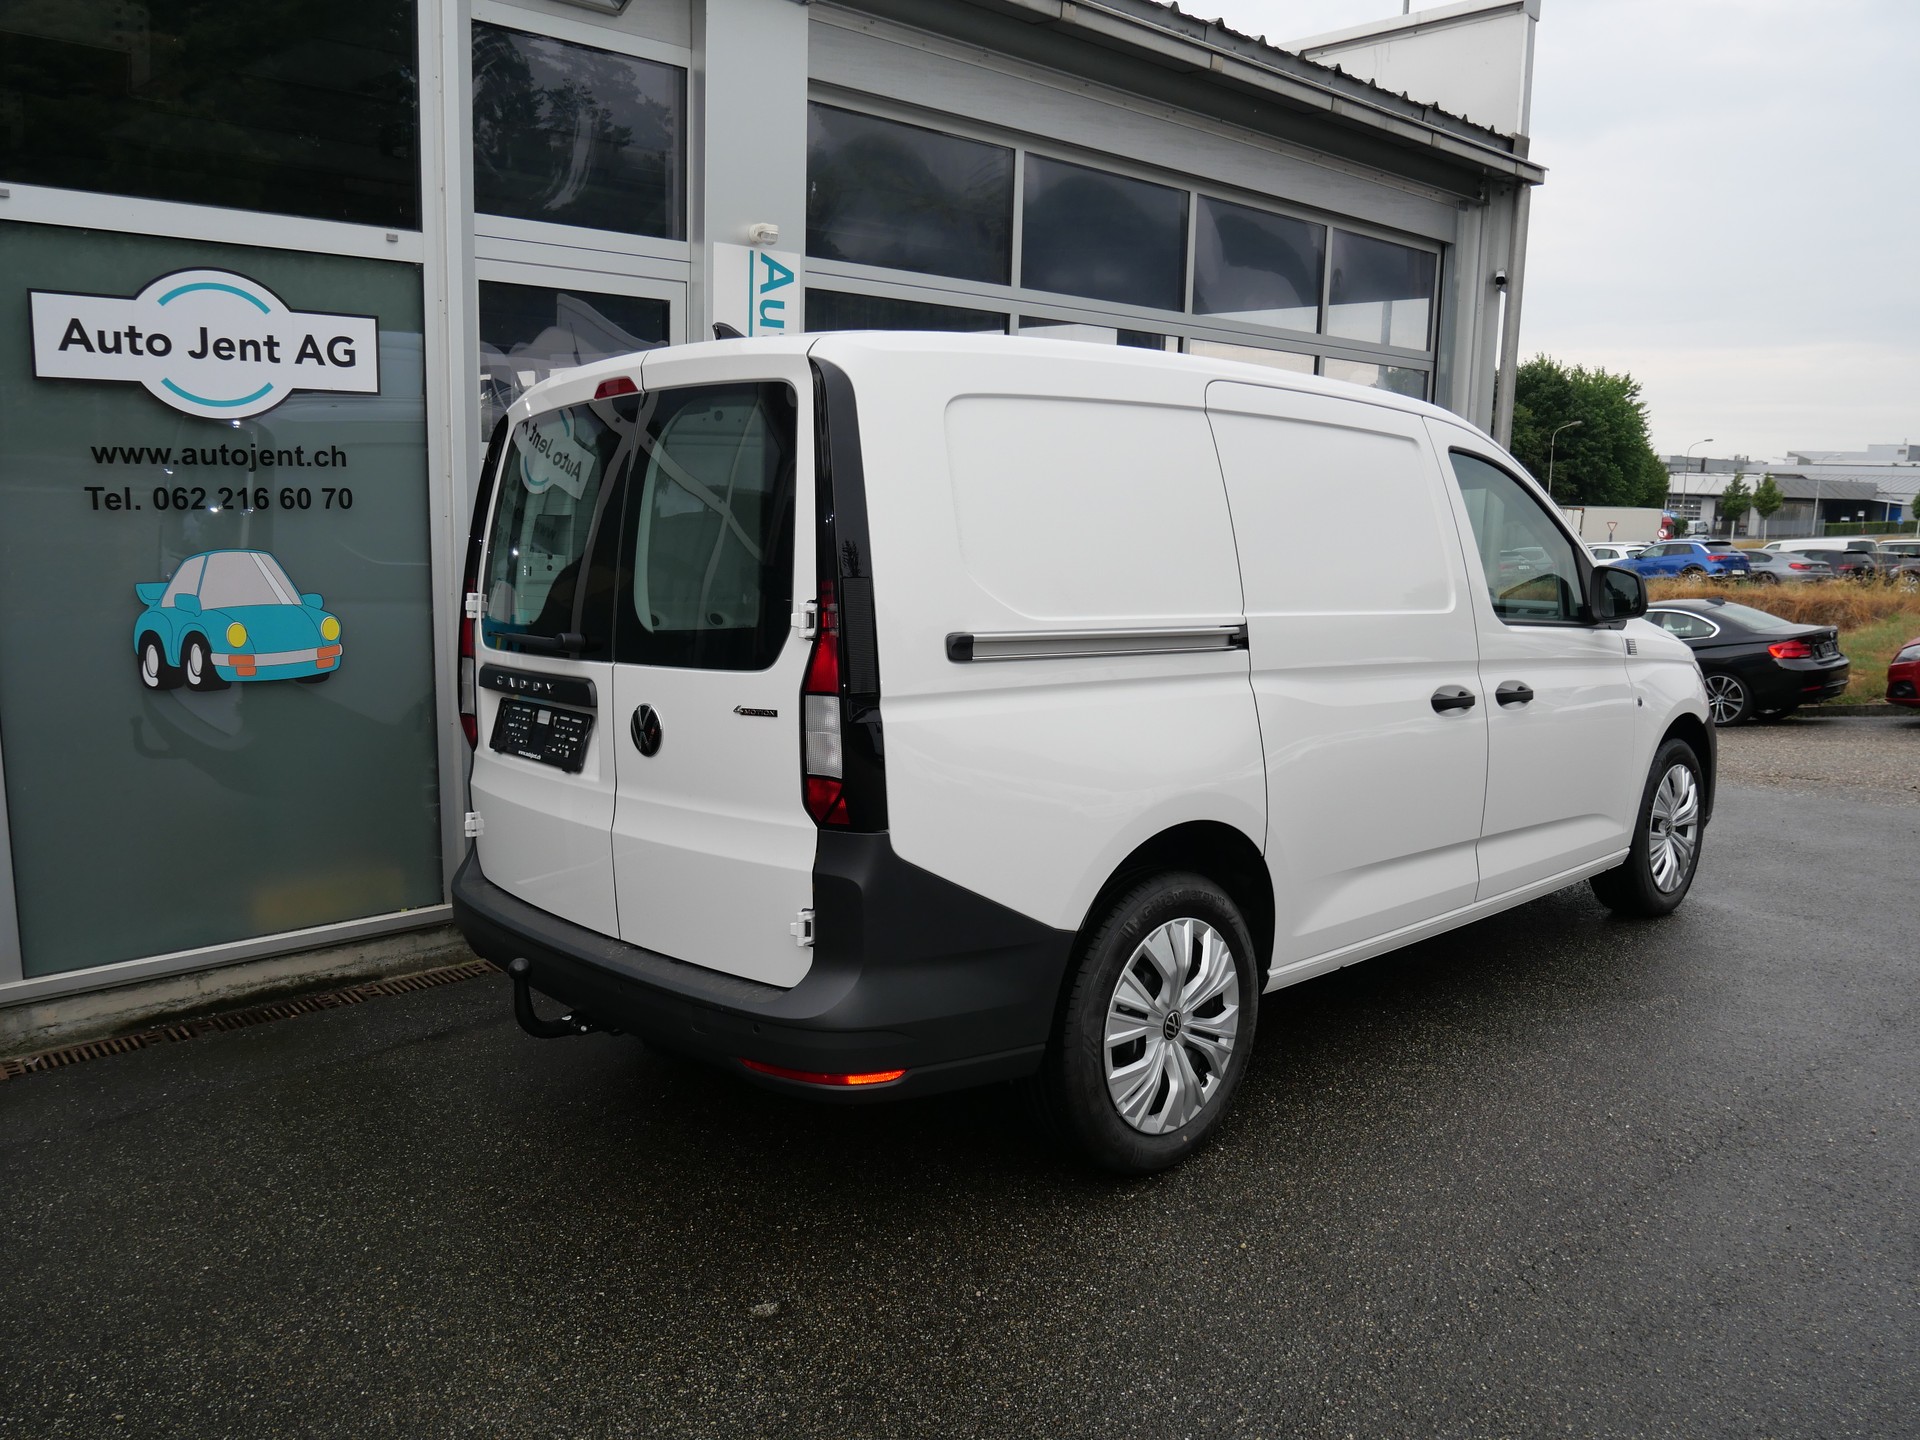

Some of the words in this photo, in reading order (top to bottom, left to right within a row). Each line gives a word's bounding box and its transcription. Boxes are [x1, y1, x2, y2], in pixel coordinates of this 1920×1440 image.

[759, 252, 795, 335] Au
[58, 317, 172, 357] Auto
[187, 326, 281, 364] Jent
[294, 334, 356, 367] AG
[90, 443, 347, 472] www.autojent.ch
[84, 486, 141, 510] Tel.
[153, 487, 207, 511] 062
[217, 487, 270, 510] 216
[279, 487, 312, 510] 60
[321, 487, 354, 510] 70
[496, 675, 555, 694] CADDY
